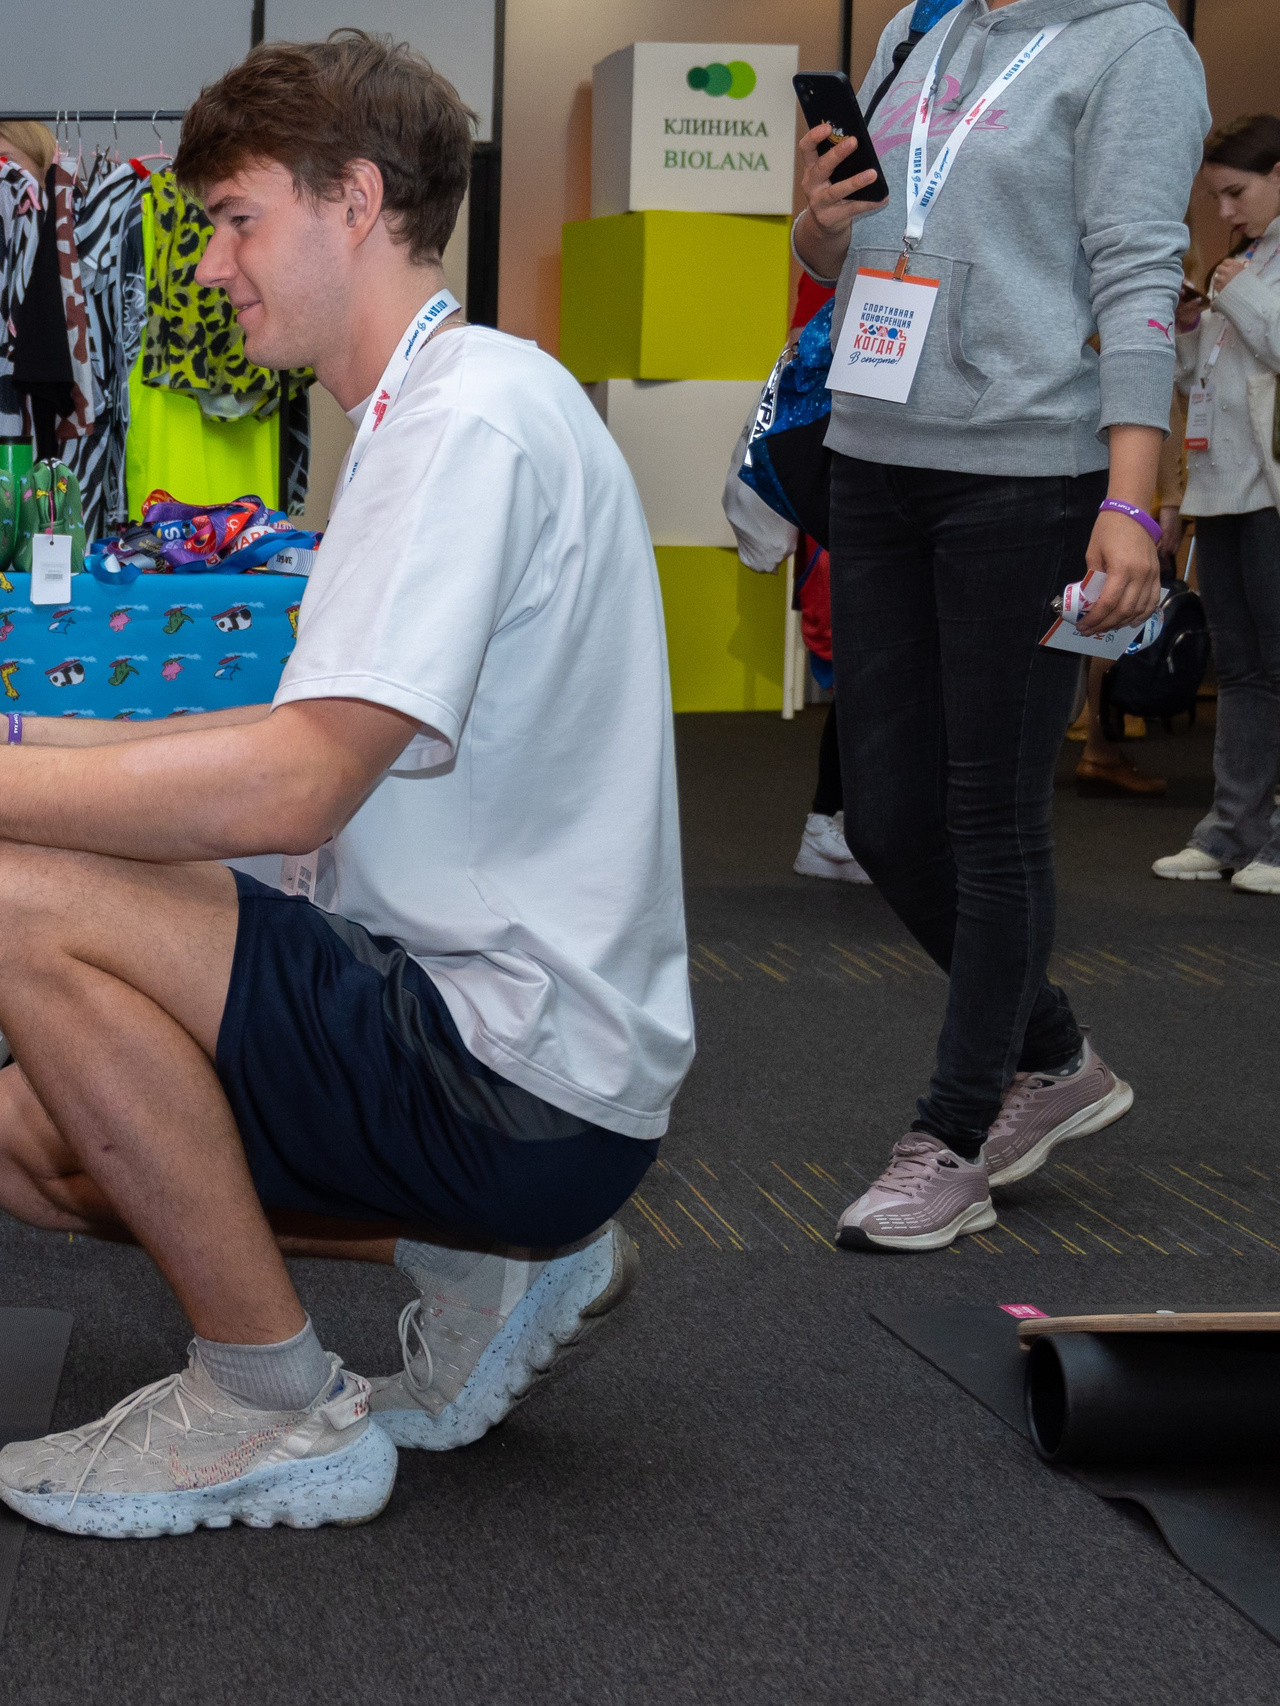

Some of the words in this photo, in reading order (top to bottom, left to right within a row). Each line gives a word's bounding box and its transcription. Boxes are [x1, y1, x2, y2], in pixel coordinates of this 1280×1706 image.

[664, 118, 768, 137] КЛИНИКА
[664, 149, 770, 171] BIOLANA
[863, 302, 915, 319] СПОРТИВНАЯ
[860, 312, 912, 329] КОНФЕРЕНЦИЯ
[853, 335, 895, 356] КОГДА
[896, 342, 907, 357] Я
[848, 351, 861, 365] В
